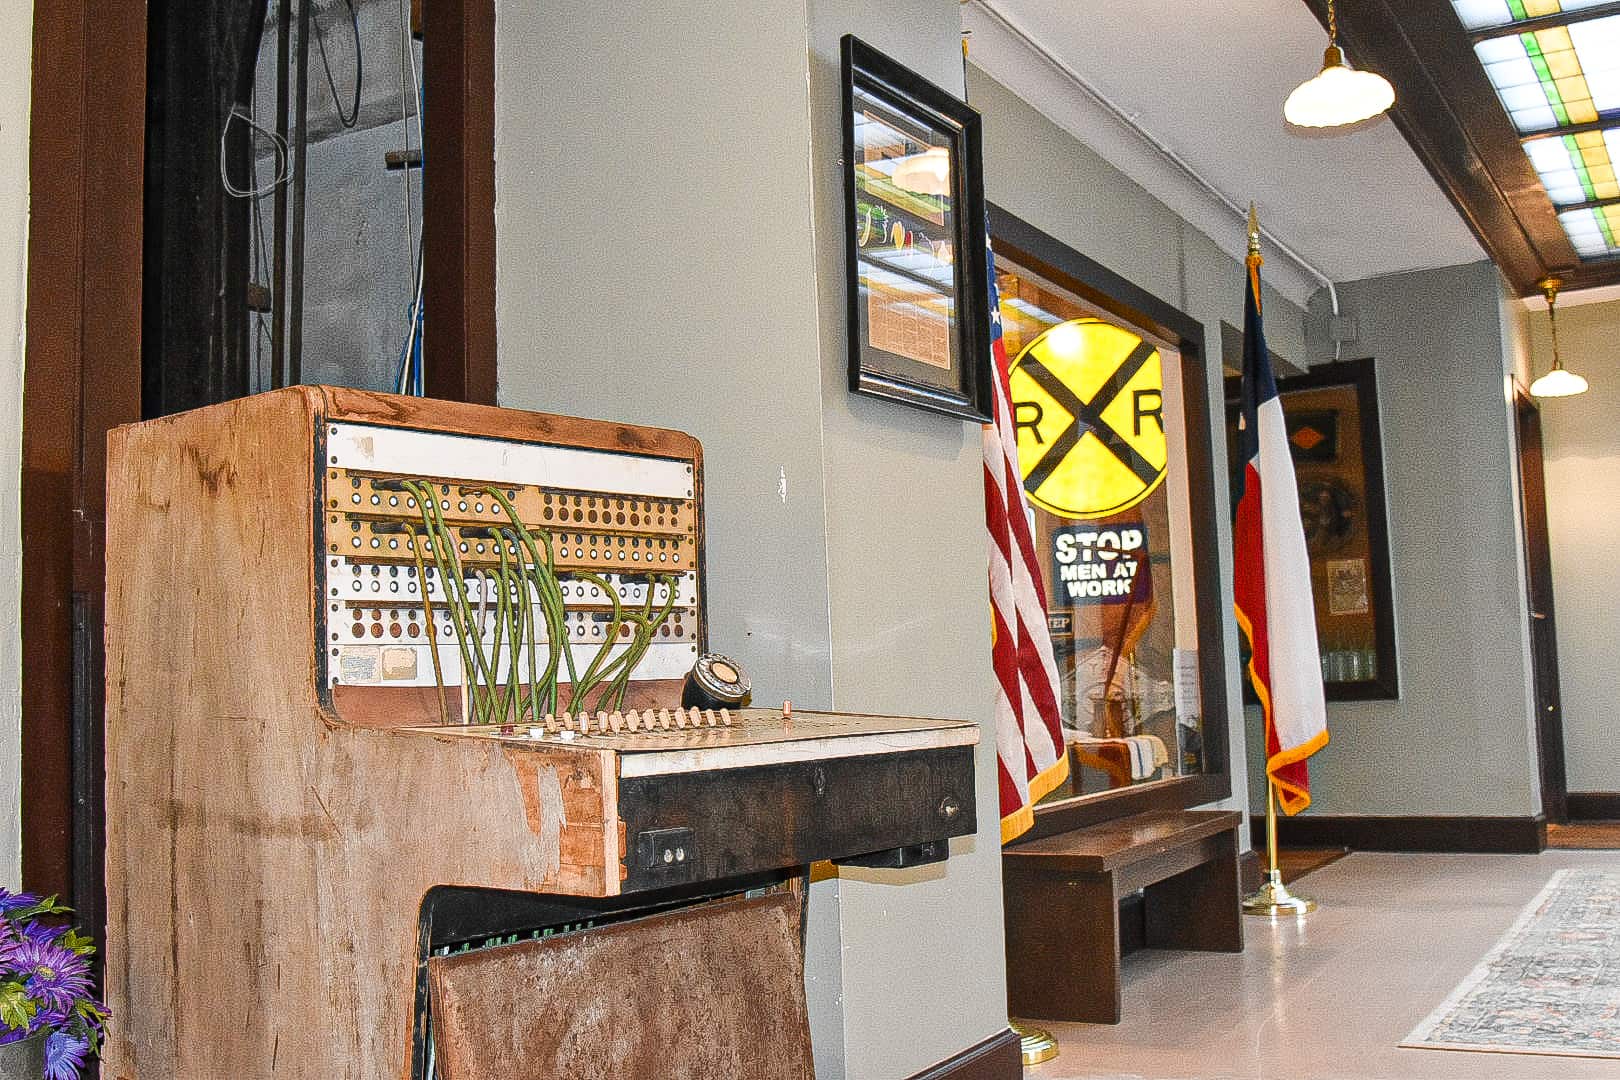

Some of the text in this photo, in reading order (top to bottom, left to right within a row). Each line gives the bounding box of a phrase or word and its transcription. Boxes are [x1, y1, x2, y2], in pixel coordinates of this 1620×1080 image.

[1013, 389, 1164, 444] R R
[1055, 529, 1143, 564] STOP
[1060, 561, 1138, 581] MEN AT
[1066, 579, 1132, 598] WORK
